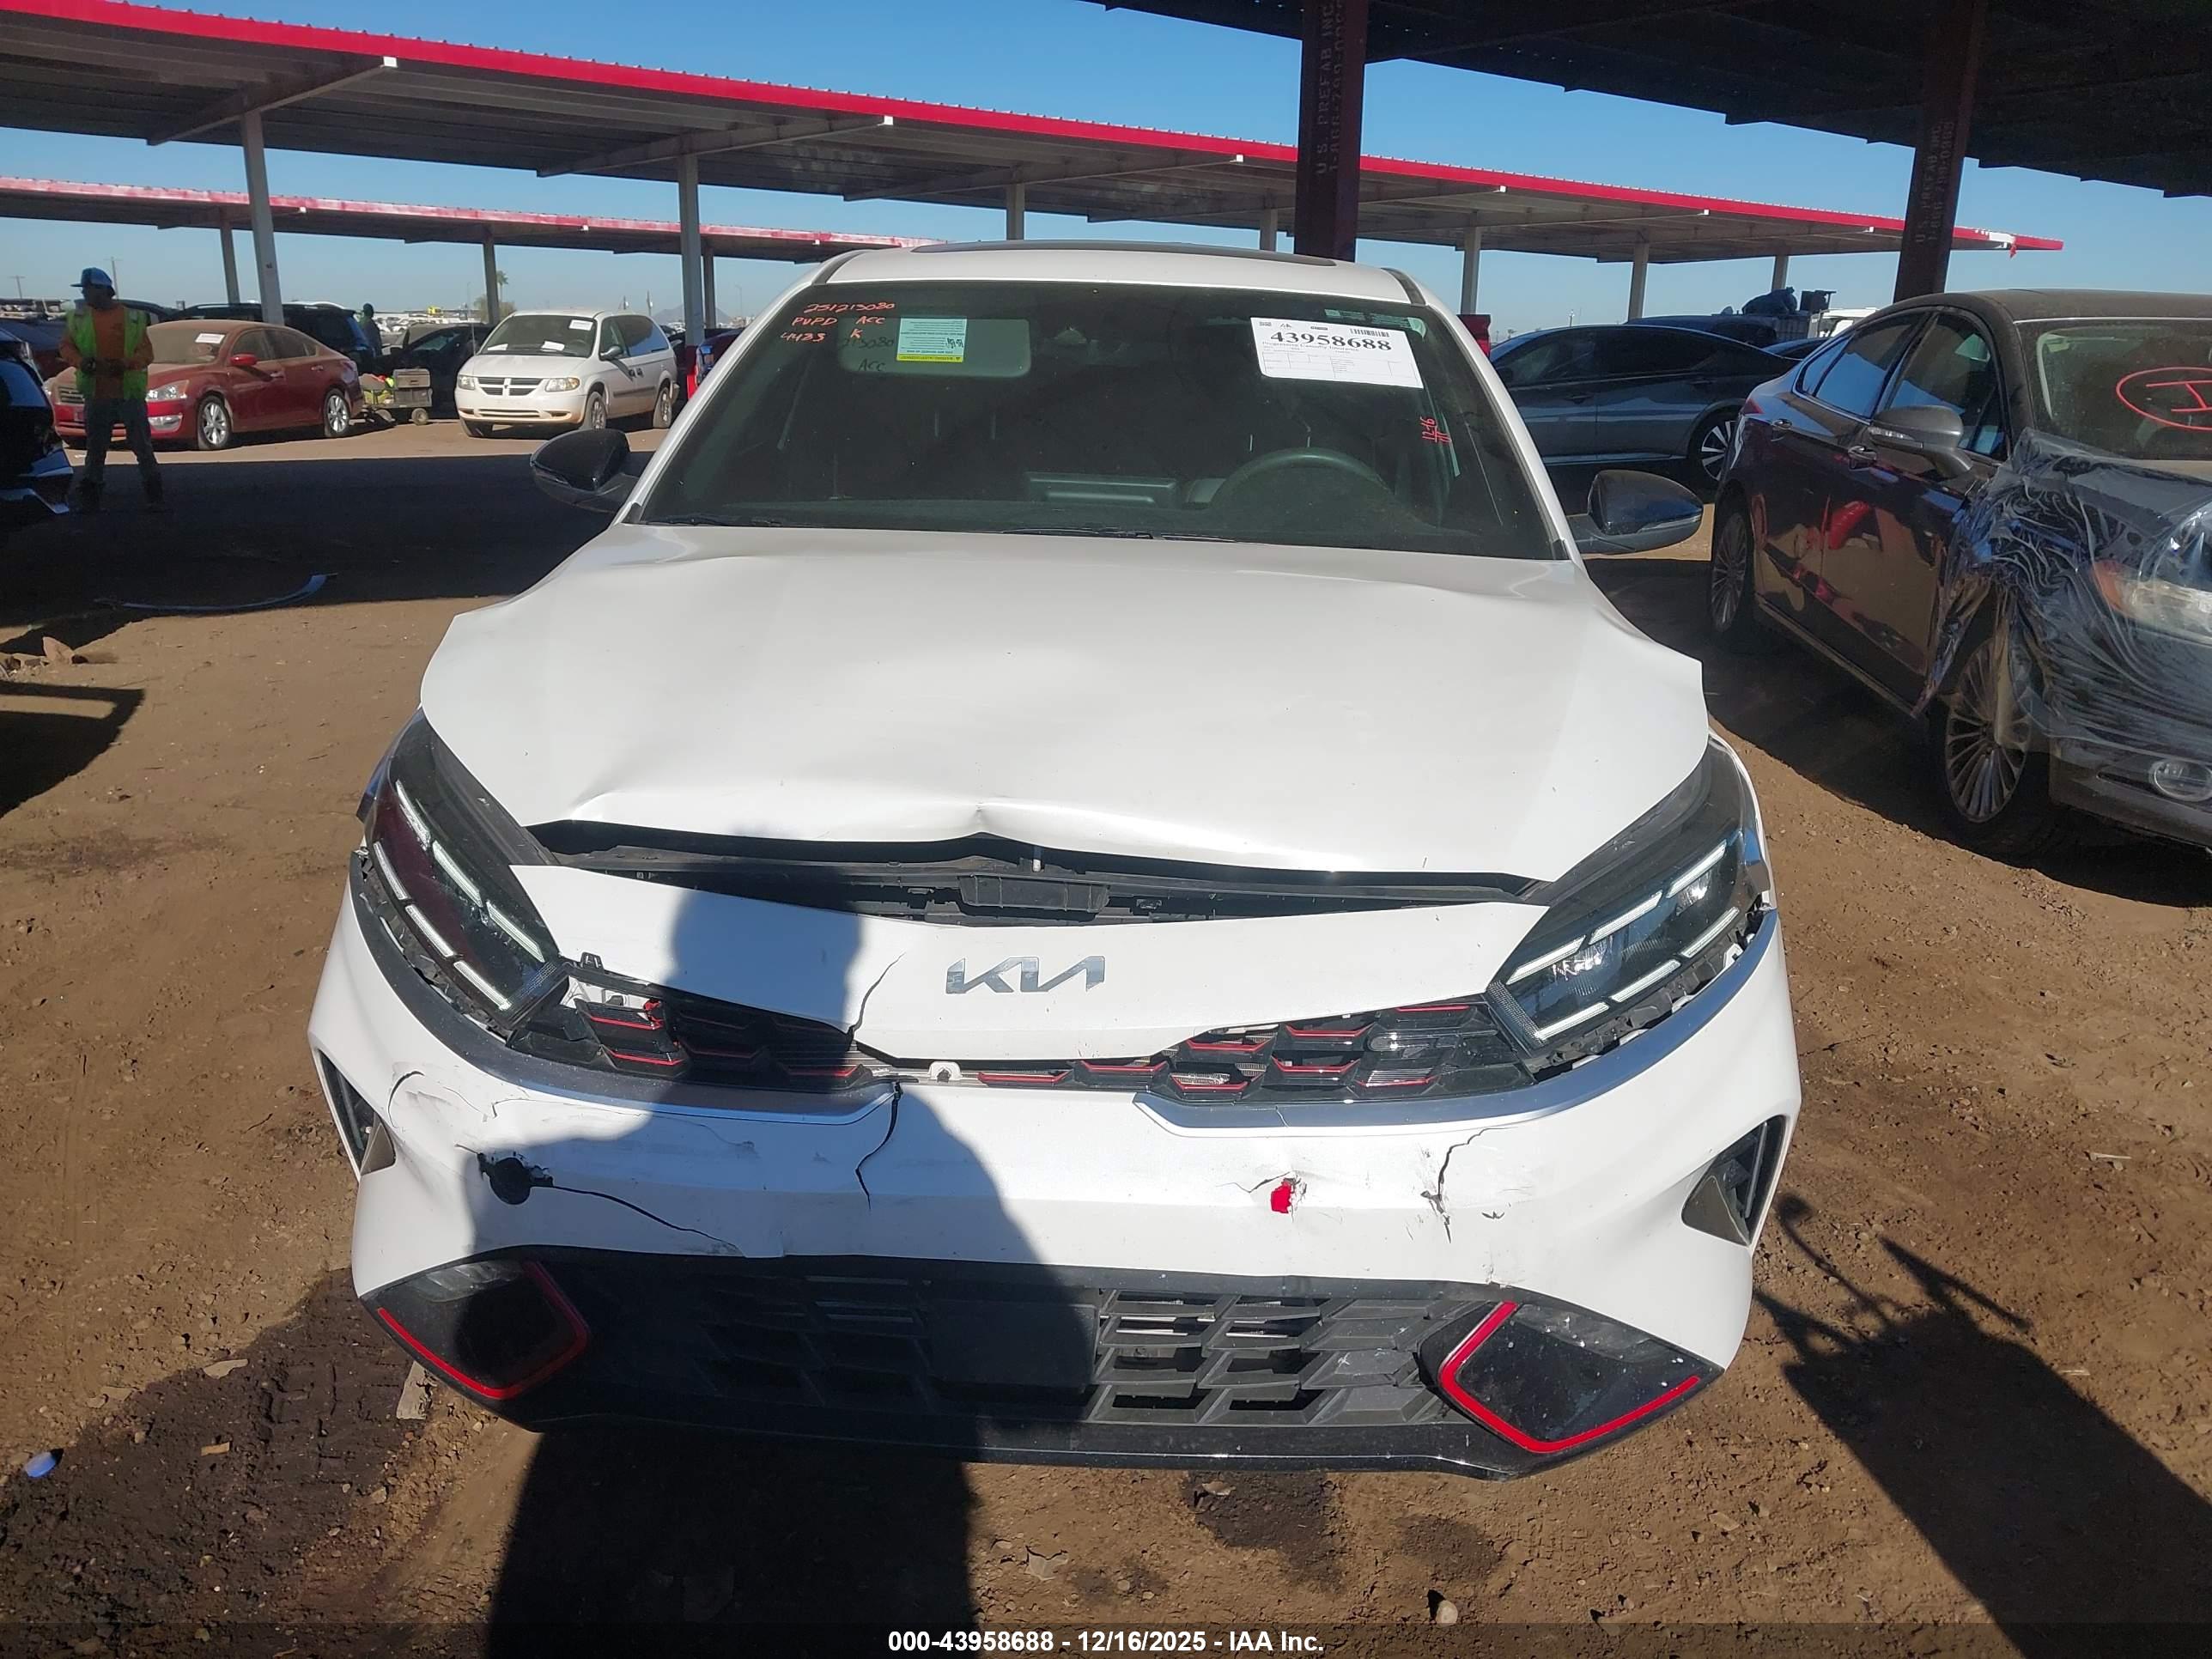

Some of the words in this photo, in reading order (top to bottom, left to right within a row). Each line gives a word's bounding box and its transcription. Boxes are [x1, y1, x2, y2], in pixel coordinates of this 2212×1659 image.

[1317, 48, 1332, 125] PREFAB
[855, 315, 886, 325] ACC
[1271, 331, 1392, 350] 43958688
[945, 956, 1105, 994] KIA
